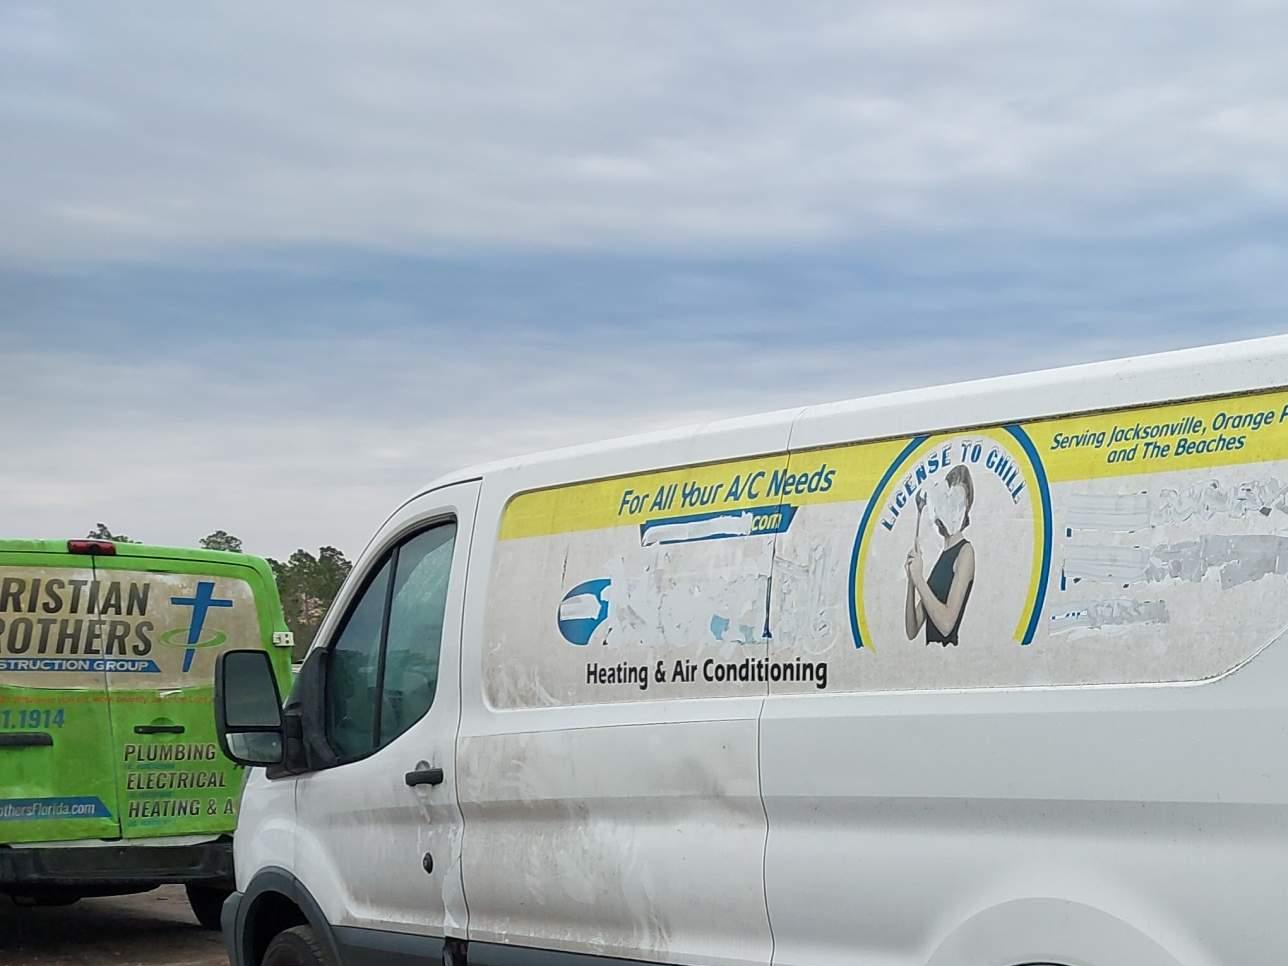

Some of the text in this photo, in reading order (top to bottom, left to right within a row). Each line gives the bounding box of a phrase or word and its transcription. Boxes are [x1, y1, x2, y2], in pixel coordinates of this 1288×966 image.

[1050, 430, 1105, 450] Serving
[1107, 416, 1207, 448] Jacksonville,
[1212, 409, 1275, 431] Orange
[1107, 434, 1246, 463] and The Beaches
[618, 463, 837, 516] For All Your A/C Needs
[881, 439, 1027, 531] LICENSE TO CHILL
[93, 660, 149, 672] GROUP
[586, 657, 828, 690] Heating & Air Conditioning
[124, 743, 216, 762] PLUMBING
[127, 772, 227, 790] ELECTRICAL
[128, 799, 200, 818] HEATING
[207, 799, 217, 815] &
